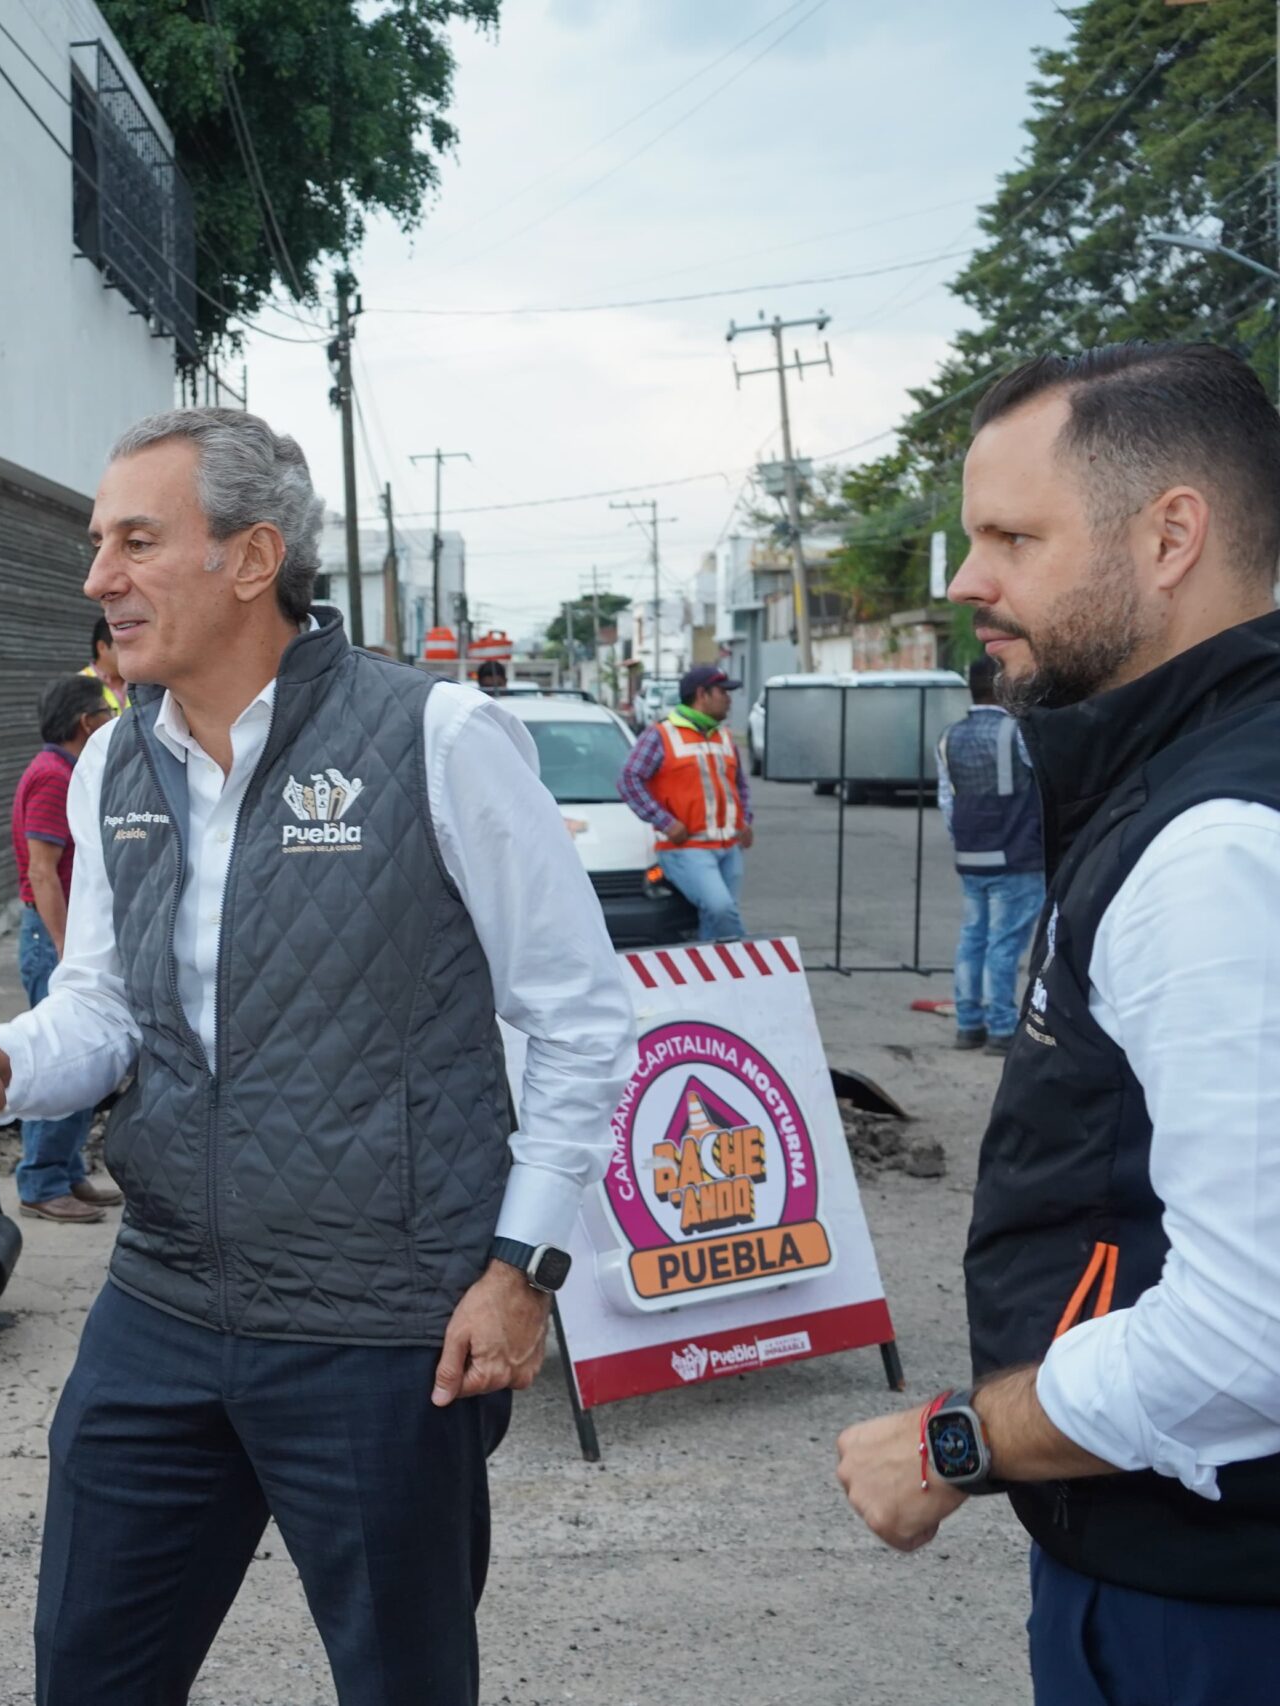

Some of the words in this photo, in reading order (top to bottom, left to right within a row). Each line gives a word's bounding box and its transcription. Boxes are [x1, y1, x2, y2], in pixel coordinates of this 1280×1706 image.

[282, 822, 362, 846] Puebla
[636, 1035, 738, 1079] CAPITALINA
[741, 1058, 807, 1189] NOCTURNA
[657, 1232, 804, 1290] PUEBLA
[709, 1343, 758, 1367] Puebla
